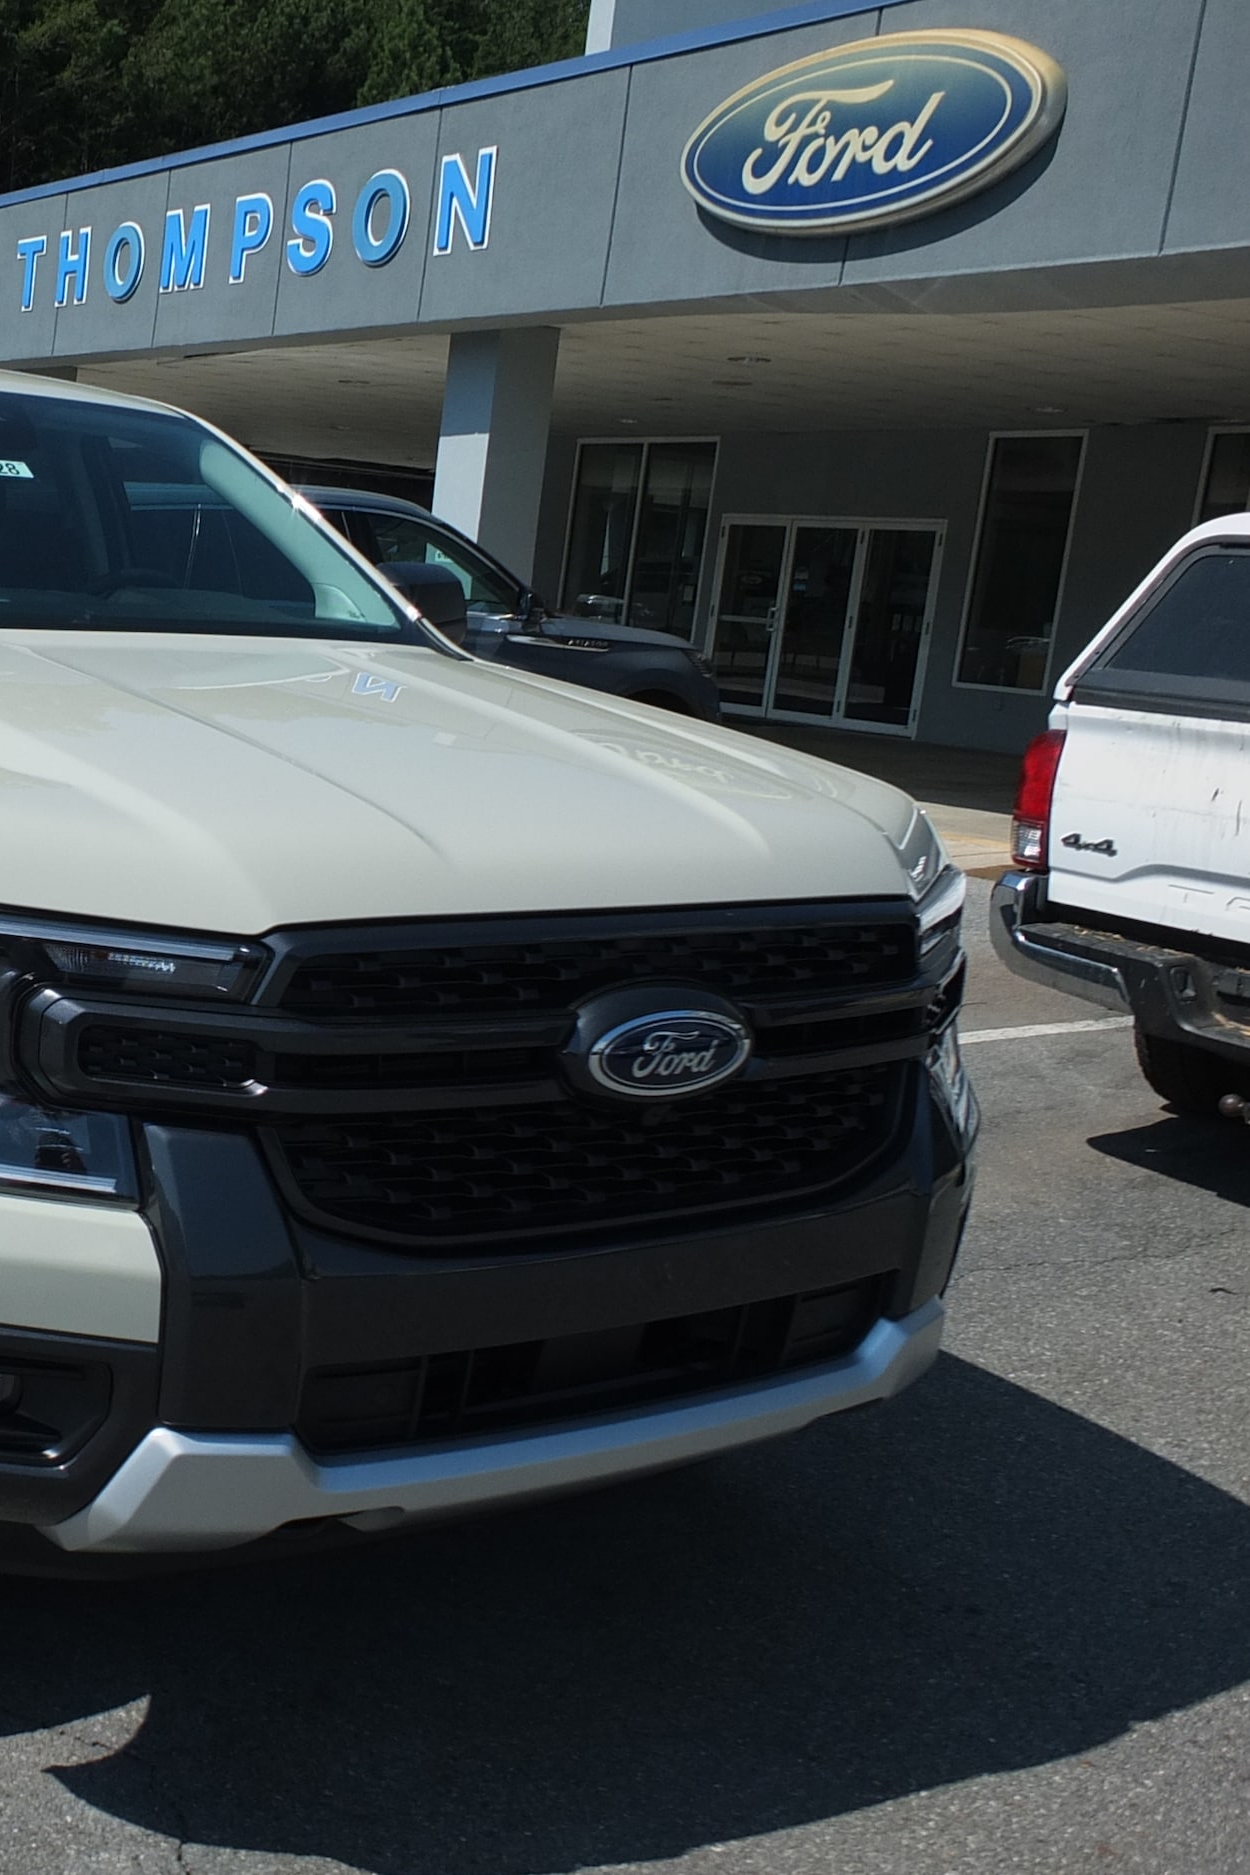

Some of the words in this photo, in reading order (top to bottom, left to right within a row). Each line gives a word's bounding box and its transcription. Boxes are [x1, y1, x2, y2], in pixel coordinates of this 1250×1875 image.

[741, 78, 946, 196] Ford
[17, 145, 499, 312] THOMPSON
[631, 1030, 720, 1078] Ford
